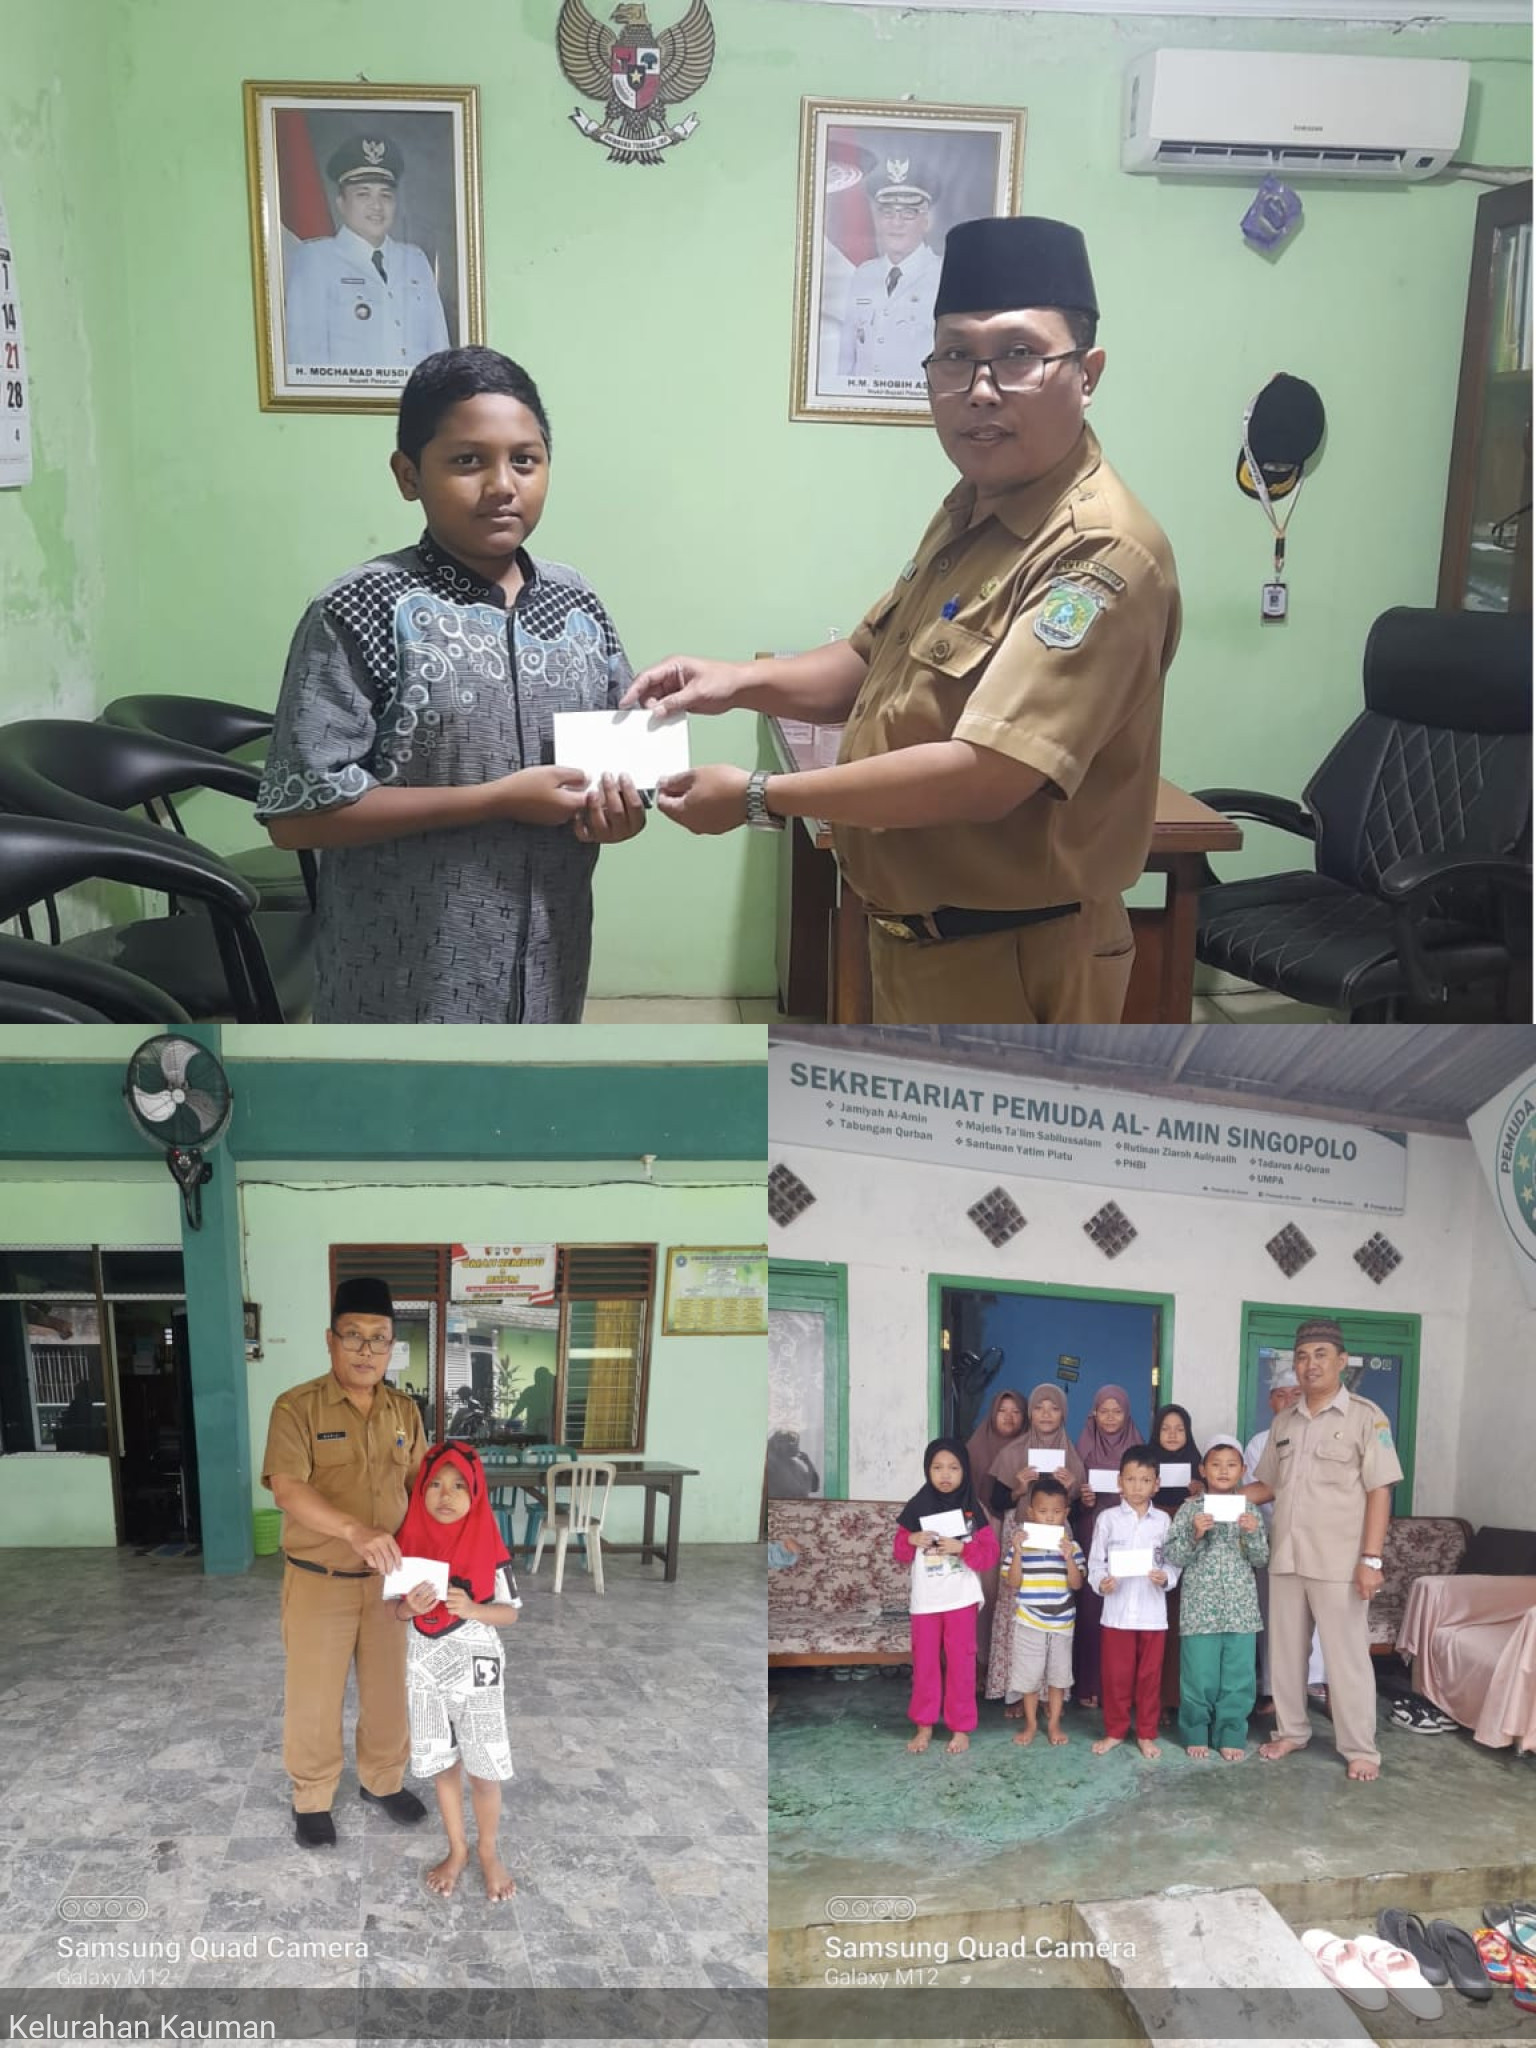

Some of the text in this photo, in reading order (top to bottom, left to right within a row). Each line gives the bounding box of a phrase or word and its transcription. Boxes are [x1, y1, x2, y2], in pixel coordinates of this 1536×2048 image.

[2, 303, 17, 330] 14
[5, 342, 20, 369] 21
[296, 367, 307, 375] H.
[310, 367, 373, 377] MOCHAMAD
[7, 381, 24, 409] 28
[873, 379, 912, 389] SHOBIH
[790, 1062, 1357, 1161] SEKRETARIAT PEMUDA AL- AMIN SINGOPOLO
[840, 1102, 928, 1124] Jamiyah Al-Amin
[840, 1119, 933, 1141] Tabungan Qurban
[965, 1120, 1003, 1135] Majelis
[1501, 1099, 1535, 1174] PEMUDA
[965, 1138, 1073, 1161] Santunan Yatim Piatu
[1123, 1159, 1147, 1170] PHBI
[1258, 1158, 1292, 1171] Tadarus
[1257, 1174, 1284, 1185] UMPA
